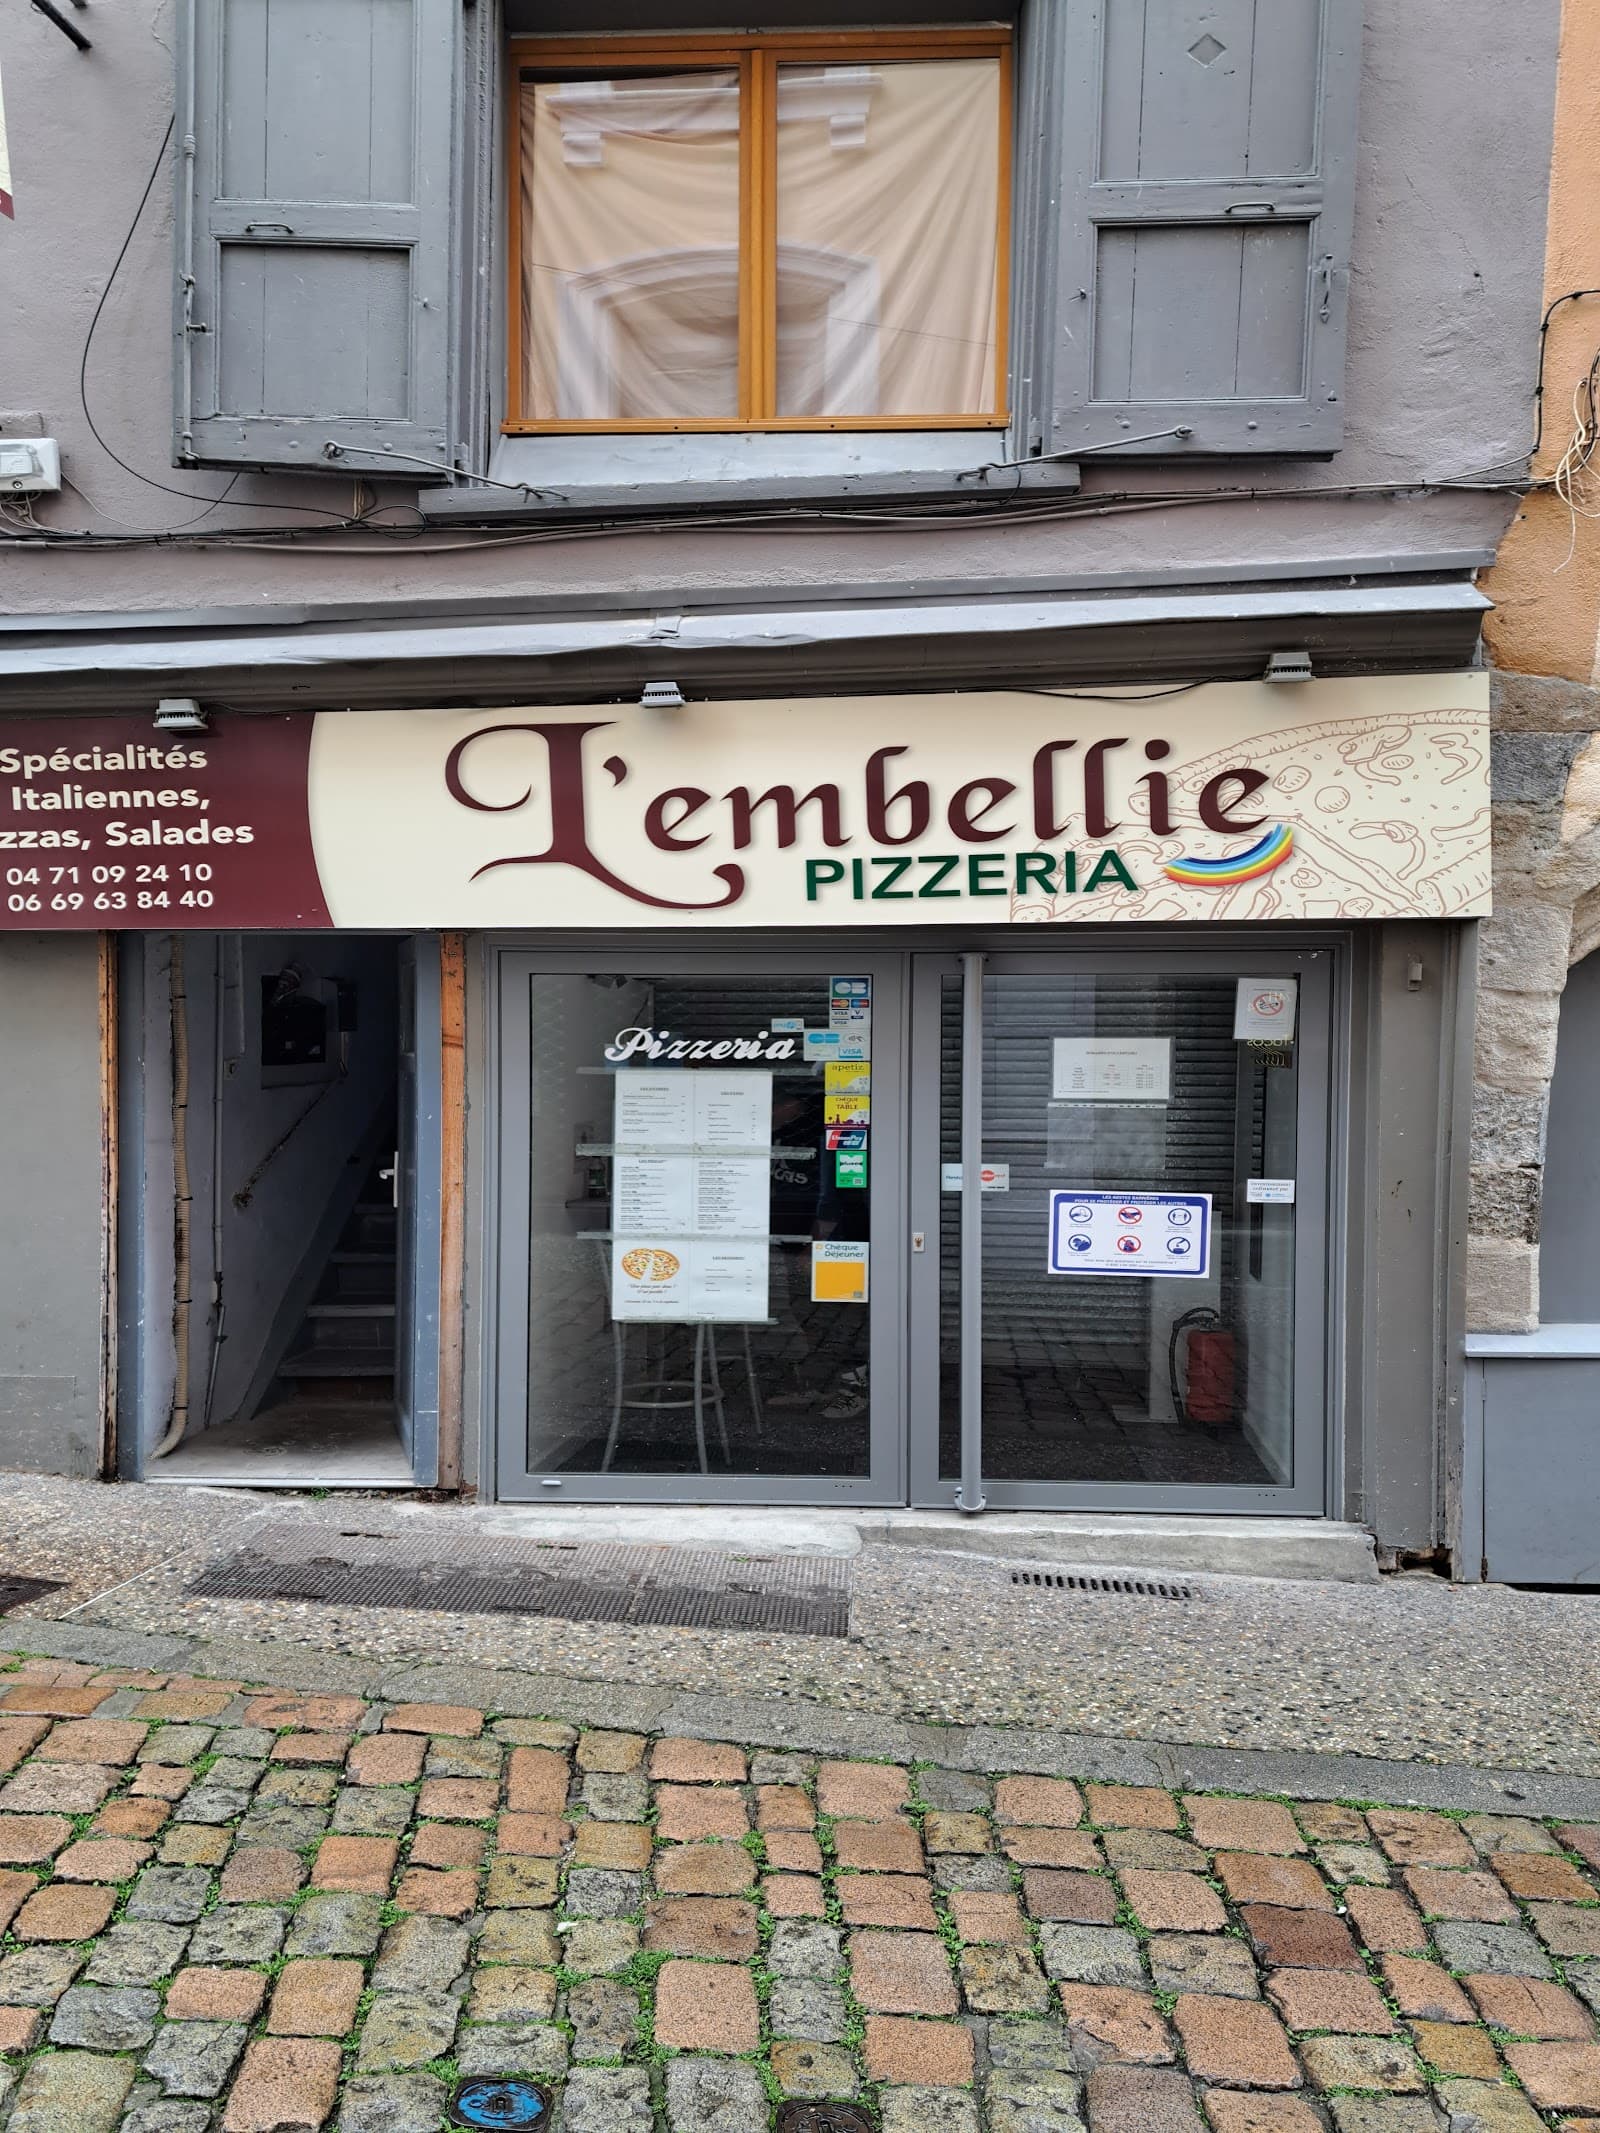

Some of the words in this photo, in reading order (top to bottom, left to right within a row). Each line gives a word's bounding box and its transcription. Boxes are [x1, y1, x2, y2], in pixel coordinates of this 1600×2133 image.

[0, 744, 208, 779] Spécialités
[11, 783, 210, 811] Italiennes,
[444, 720, 1272, 909] L'embellie
[104, 818, 255, 847] Salades
[6, 867, 41, 886] 04
[48, 866, 80, 885] 71
[91, 865, 126, 884] 09
[135, 864, 170, 883] 24
[178, 863, 213, 882] 10
[805, 849, 1139, 902] PIZZERIA
[7, 894, 42, 912] 06
[50, 892, 84, 911] 69
[93, 891, 127, 910] 63
[136, 890, 171, 908] 84
[179, 889, 214, 908] 40
[604, 1027, 796, 1061] Pizzeria
